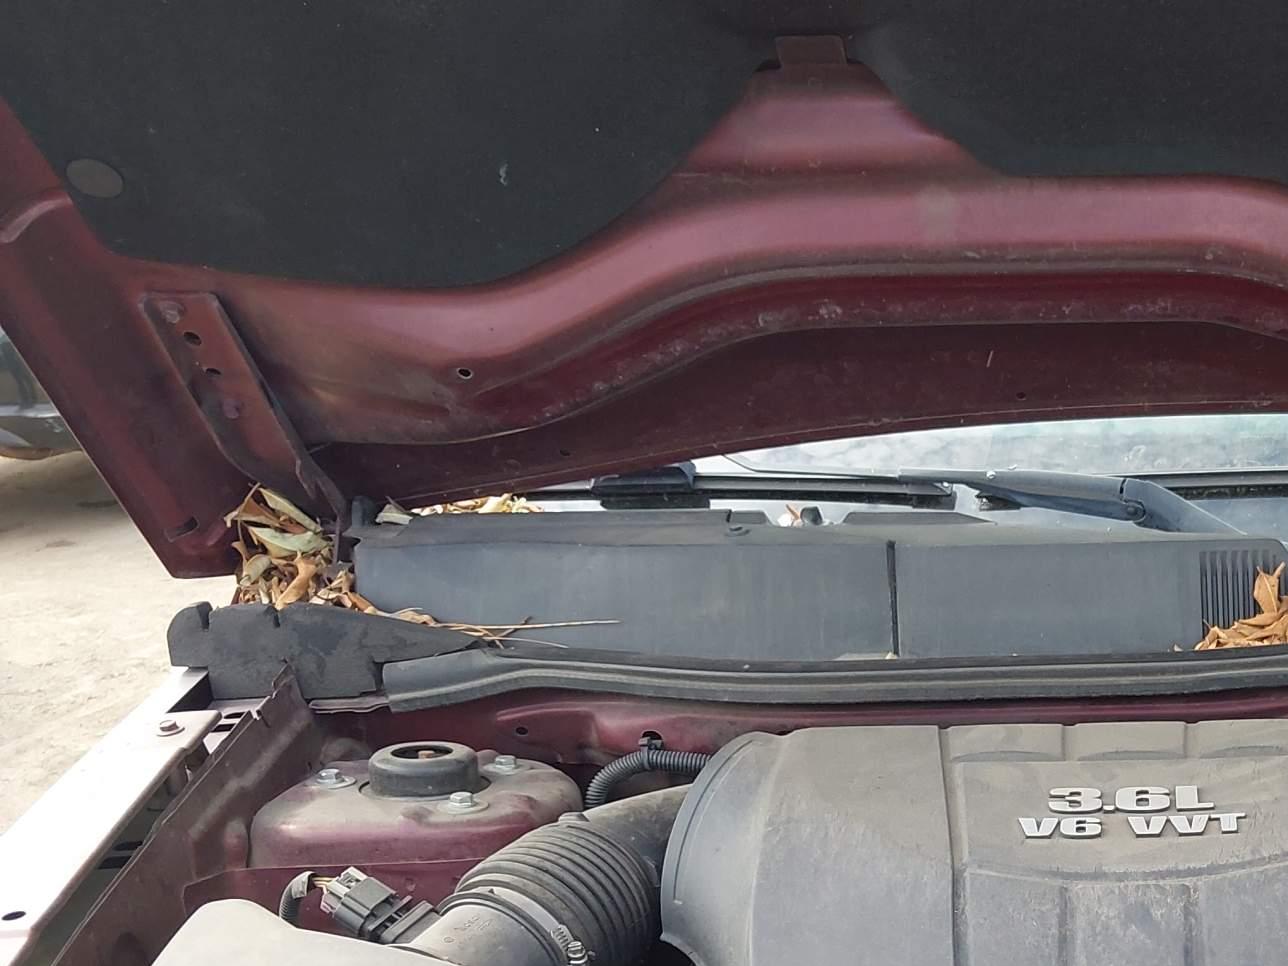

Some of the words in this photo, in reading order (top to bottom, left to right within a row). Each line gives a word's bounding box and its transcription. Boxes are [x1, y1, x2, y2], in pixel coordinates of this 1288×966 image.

[1048, 785, 1215, 814] 3.6L
[1018, 817, 1102, 838] V6
[1127, 812, 1247, 838] VVT
